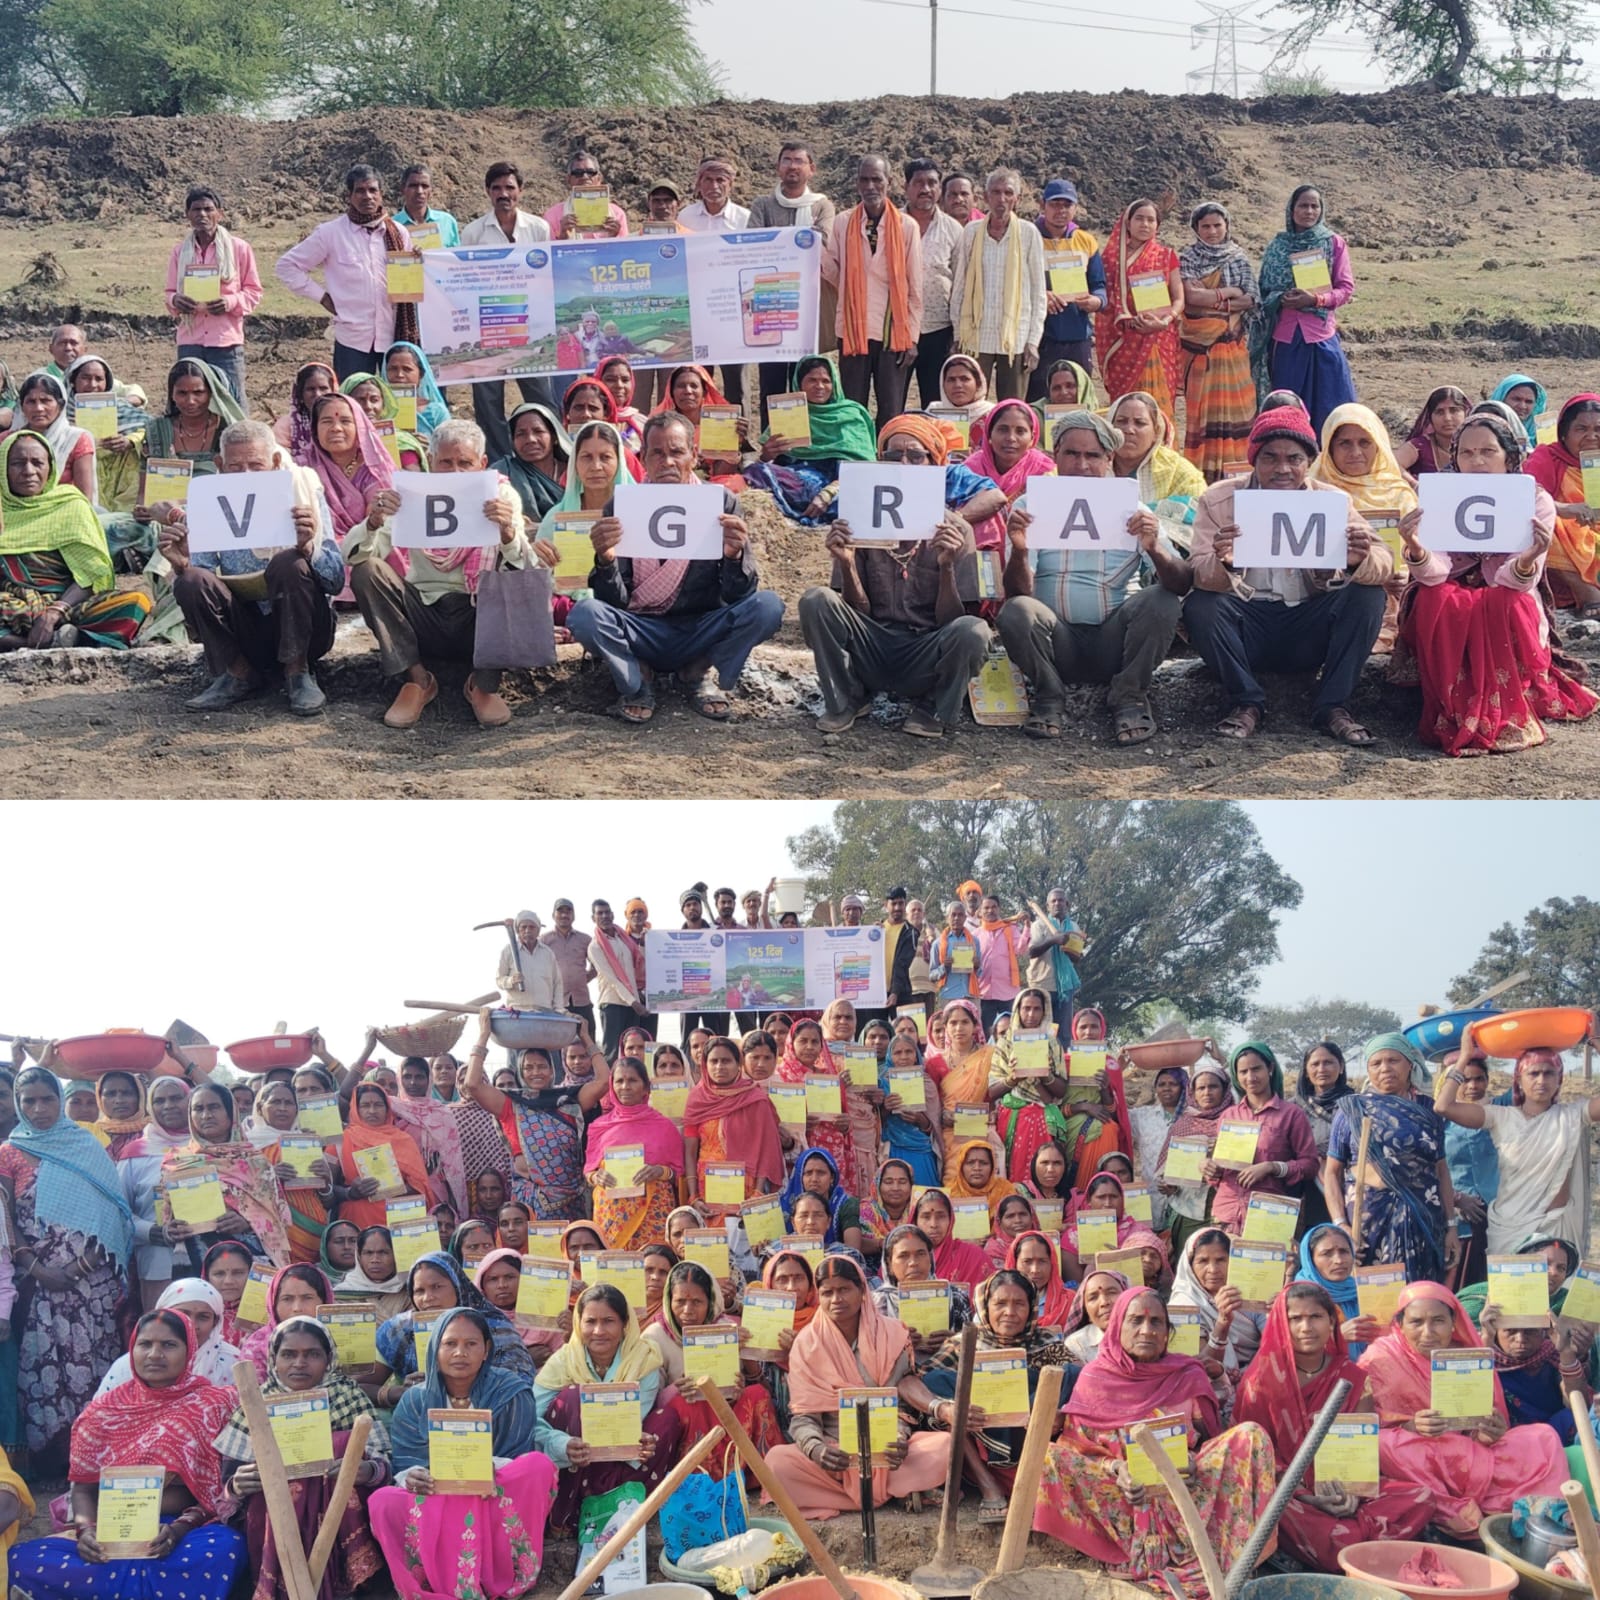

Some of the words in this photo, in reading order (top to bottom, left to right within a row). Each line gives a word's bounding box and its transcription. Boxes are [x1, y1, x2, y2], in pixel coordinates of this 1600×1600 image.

[590, 264, 618, 283] 125
[620, 259, 652, 281] दिन
[216, 493, 256, 538] V
[425, 494, 459, 538] B
[648, 505, 687, 549] G
[871, 484, 904, 529] R
[1059, 498, 1100, 540] A
[1454, 495, 1496, 541] G
[1270, 512, 1326, 557] M
[747, 946, 764, 958] 125
